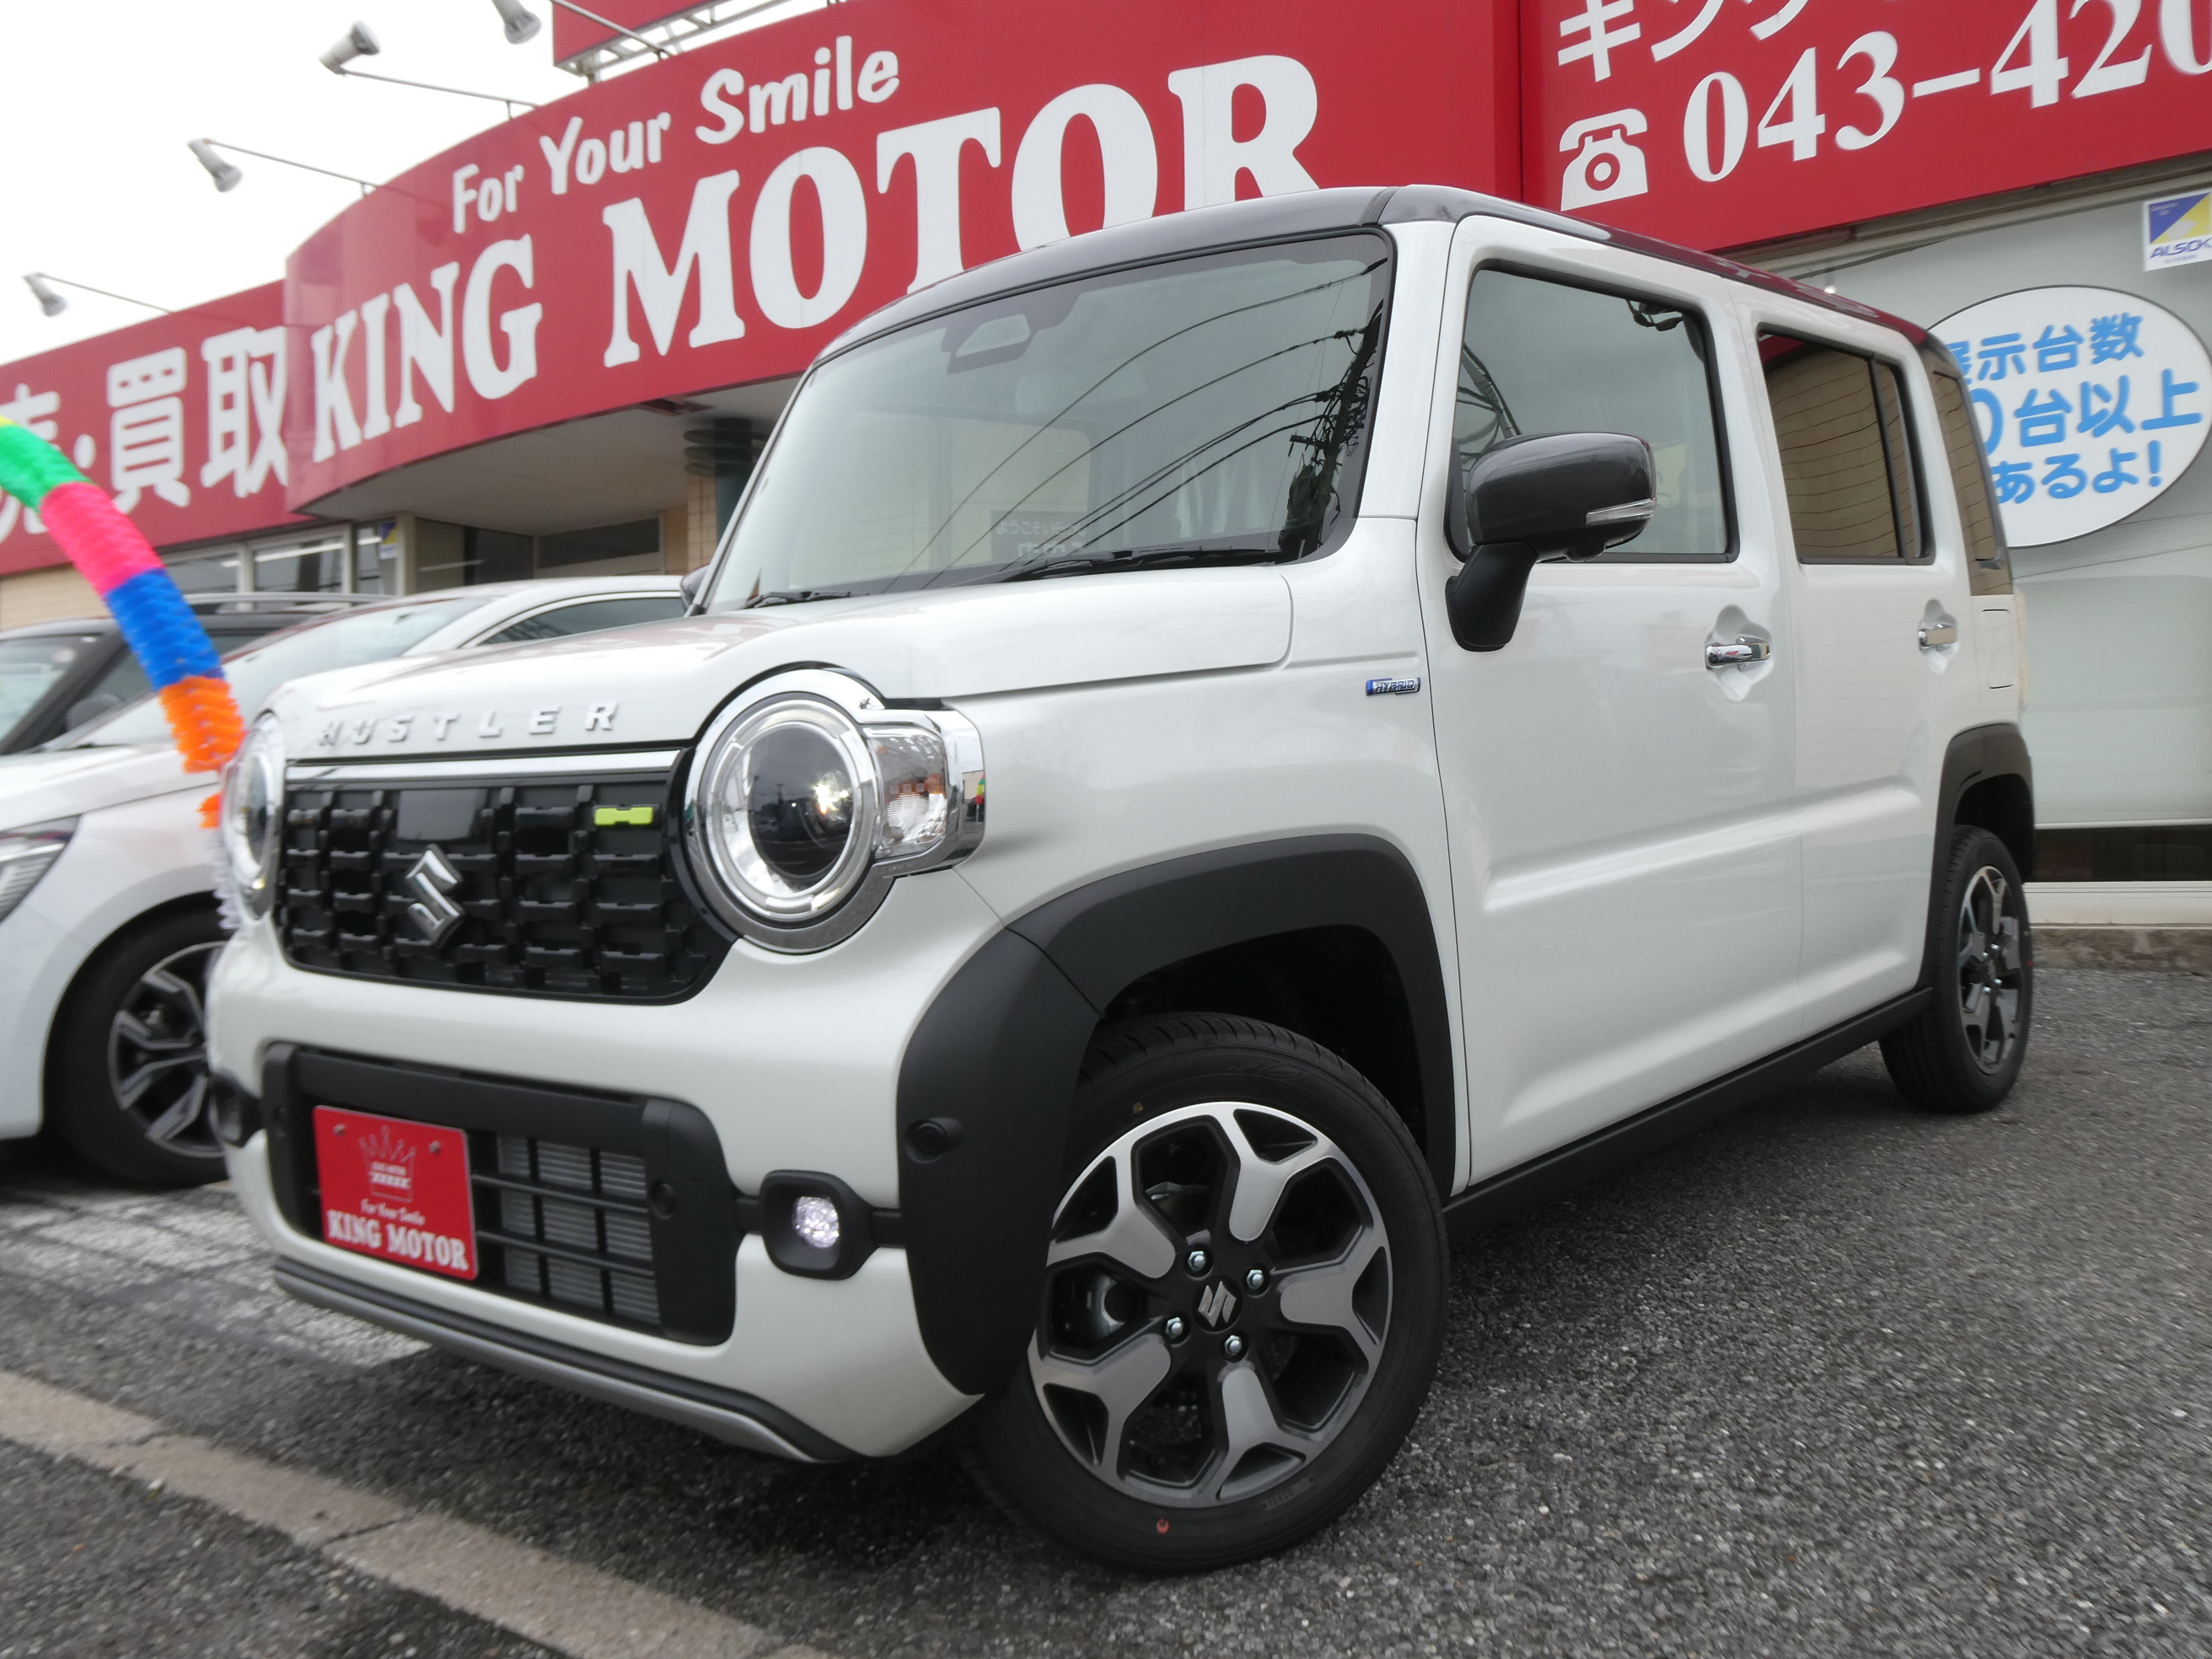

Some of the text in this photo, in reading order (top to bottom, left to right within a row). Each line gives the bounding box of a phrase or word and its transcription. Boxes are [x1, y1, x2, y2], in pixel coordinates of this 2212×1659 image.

[452, 35, 900, 234] For Your Smile
[311, 55, 1321, 464] KING MOTOR
[1376, 679, 1415, 693] HYBRID
[318, 701, 620, 745] HUSTLER
[326, 1209, 470, 1272] KING MOTOR
